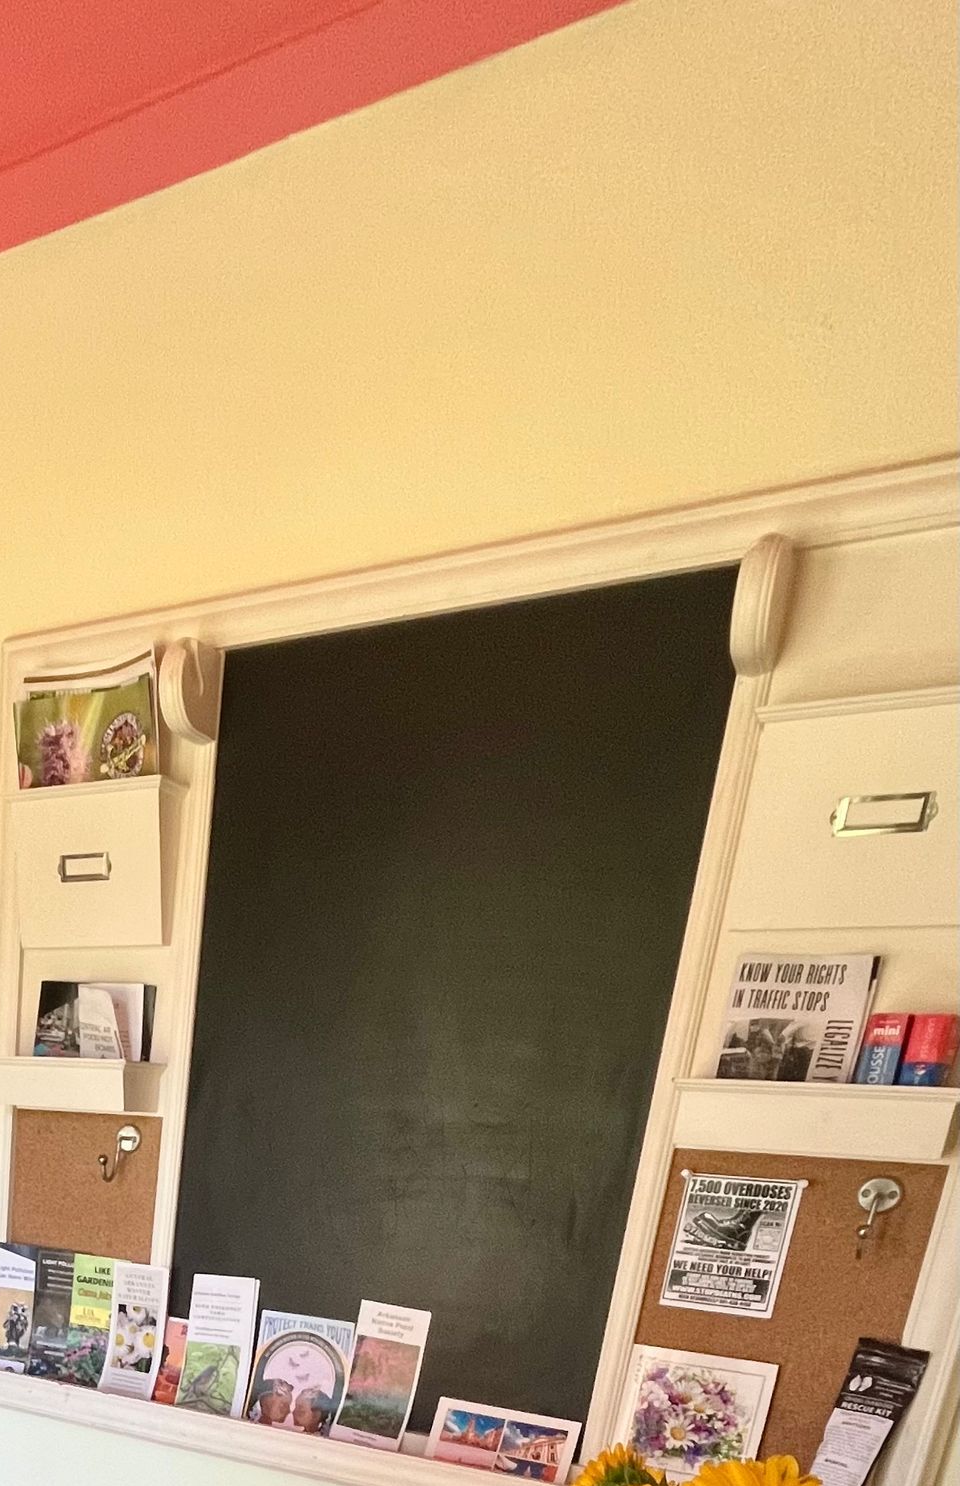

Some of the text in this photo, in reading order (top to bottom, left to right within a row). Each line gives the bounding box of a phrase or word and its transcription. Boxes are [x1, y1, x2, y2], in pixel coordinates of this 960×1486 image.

[738, 962, 848, 985] KNOW YOUR RIGHTS
[732, 989, 830, 1012] IN TRAFFIC STOPS
[873, 1024, 901, 1036] mini
[723, 1181, 792, 1200] OVERDOSES
[733, 1198, 761, 1210] SINCE
[763, 1200, 788, 1212] 2020
[94, 1266, 111, 1276] LIKE
[673, 1259, 773, 1280] WE NEED YOUR HELP!
[842, 1401, 893, 1417] RESCUE KIT
